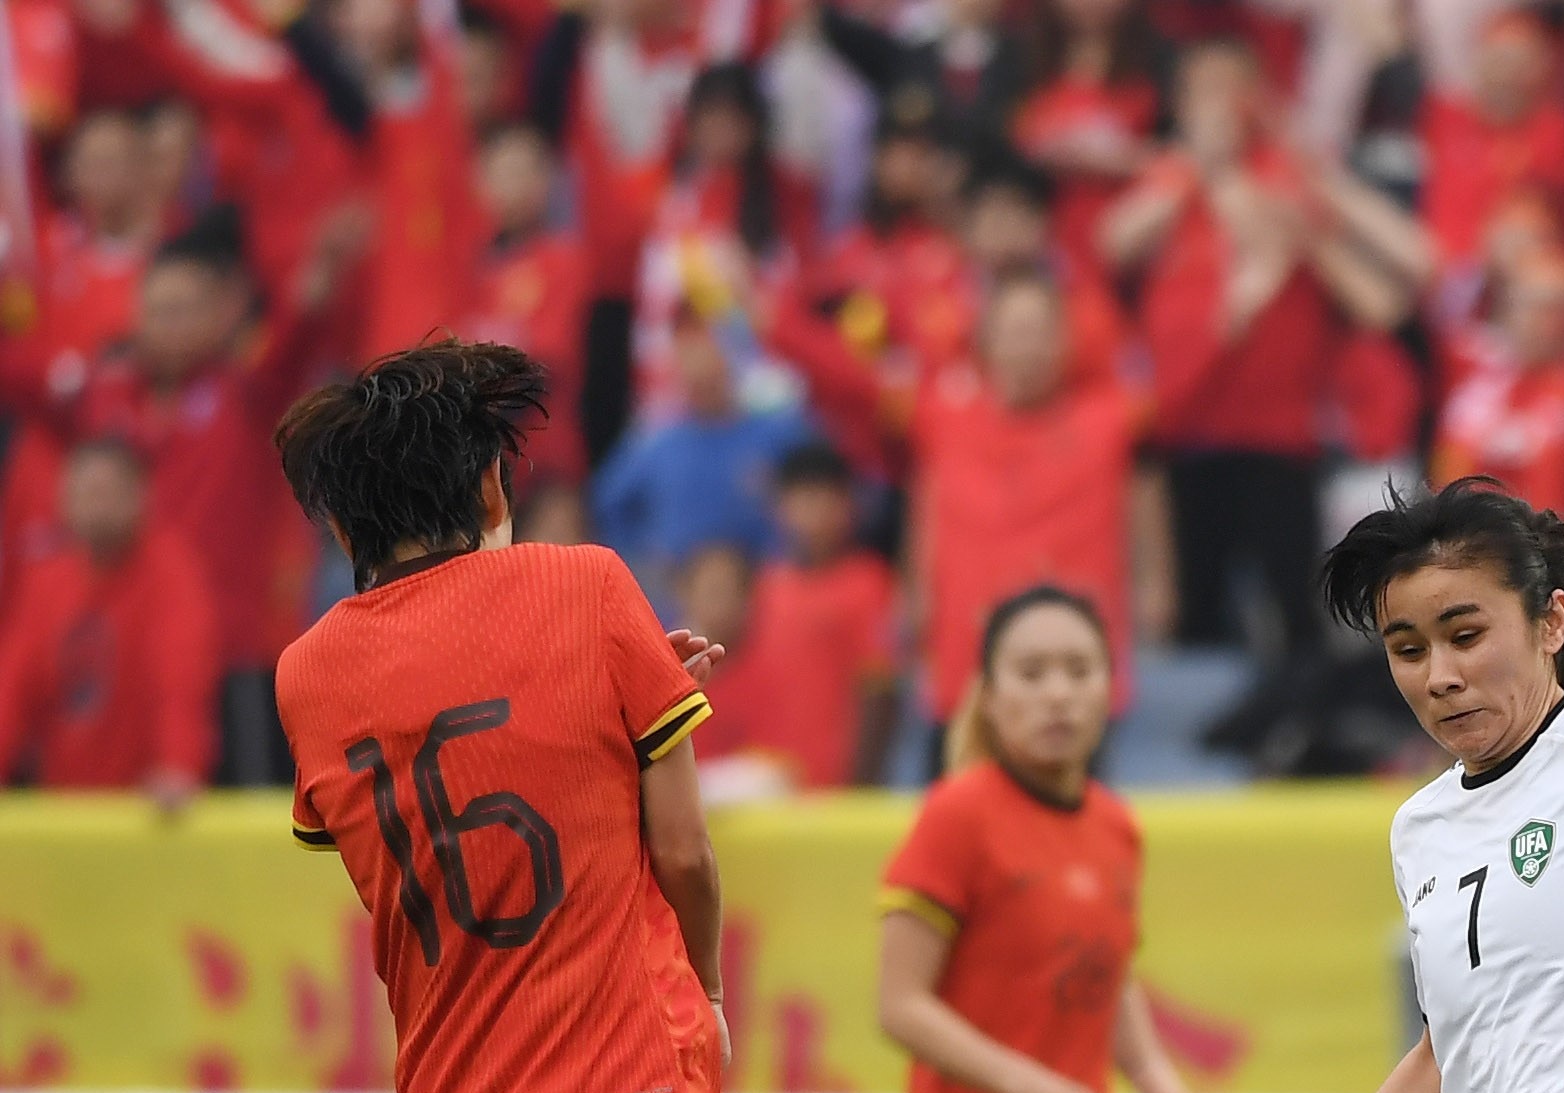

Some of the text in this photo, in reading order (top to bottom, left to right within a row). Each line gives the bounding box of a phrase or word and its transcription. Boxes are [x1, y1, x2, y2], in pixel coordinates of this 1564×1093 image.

[343, 697, 565, 968] 16
[1515, 830, 1548, 858] UFA
[1458, 864, 1489, 971] 7
